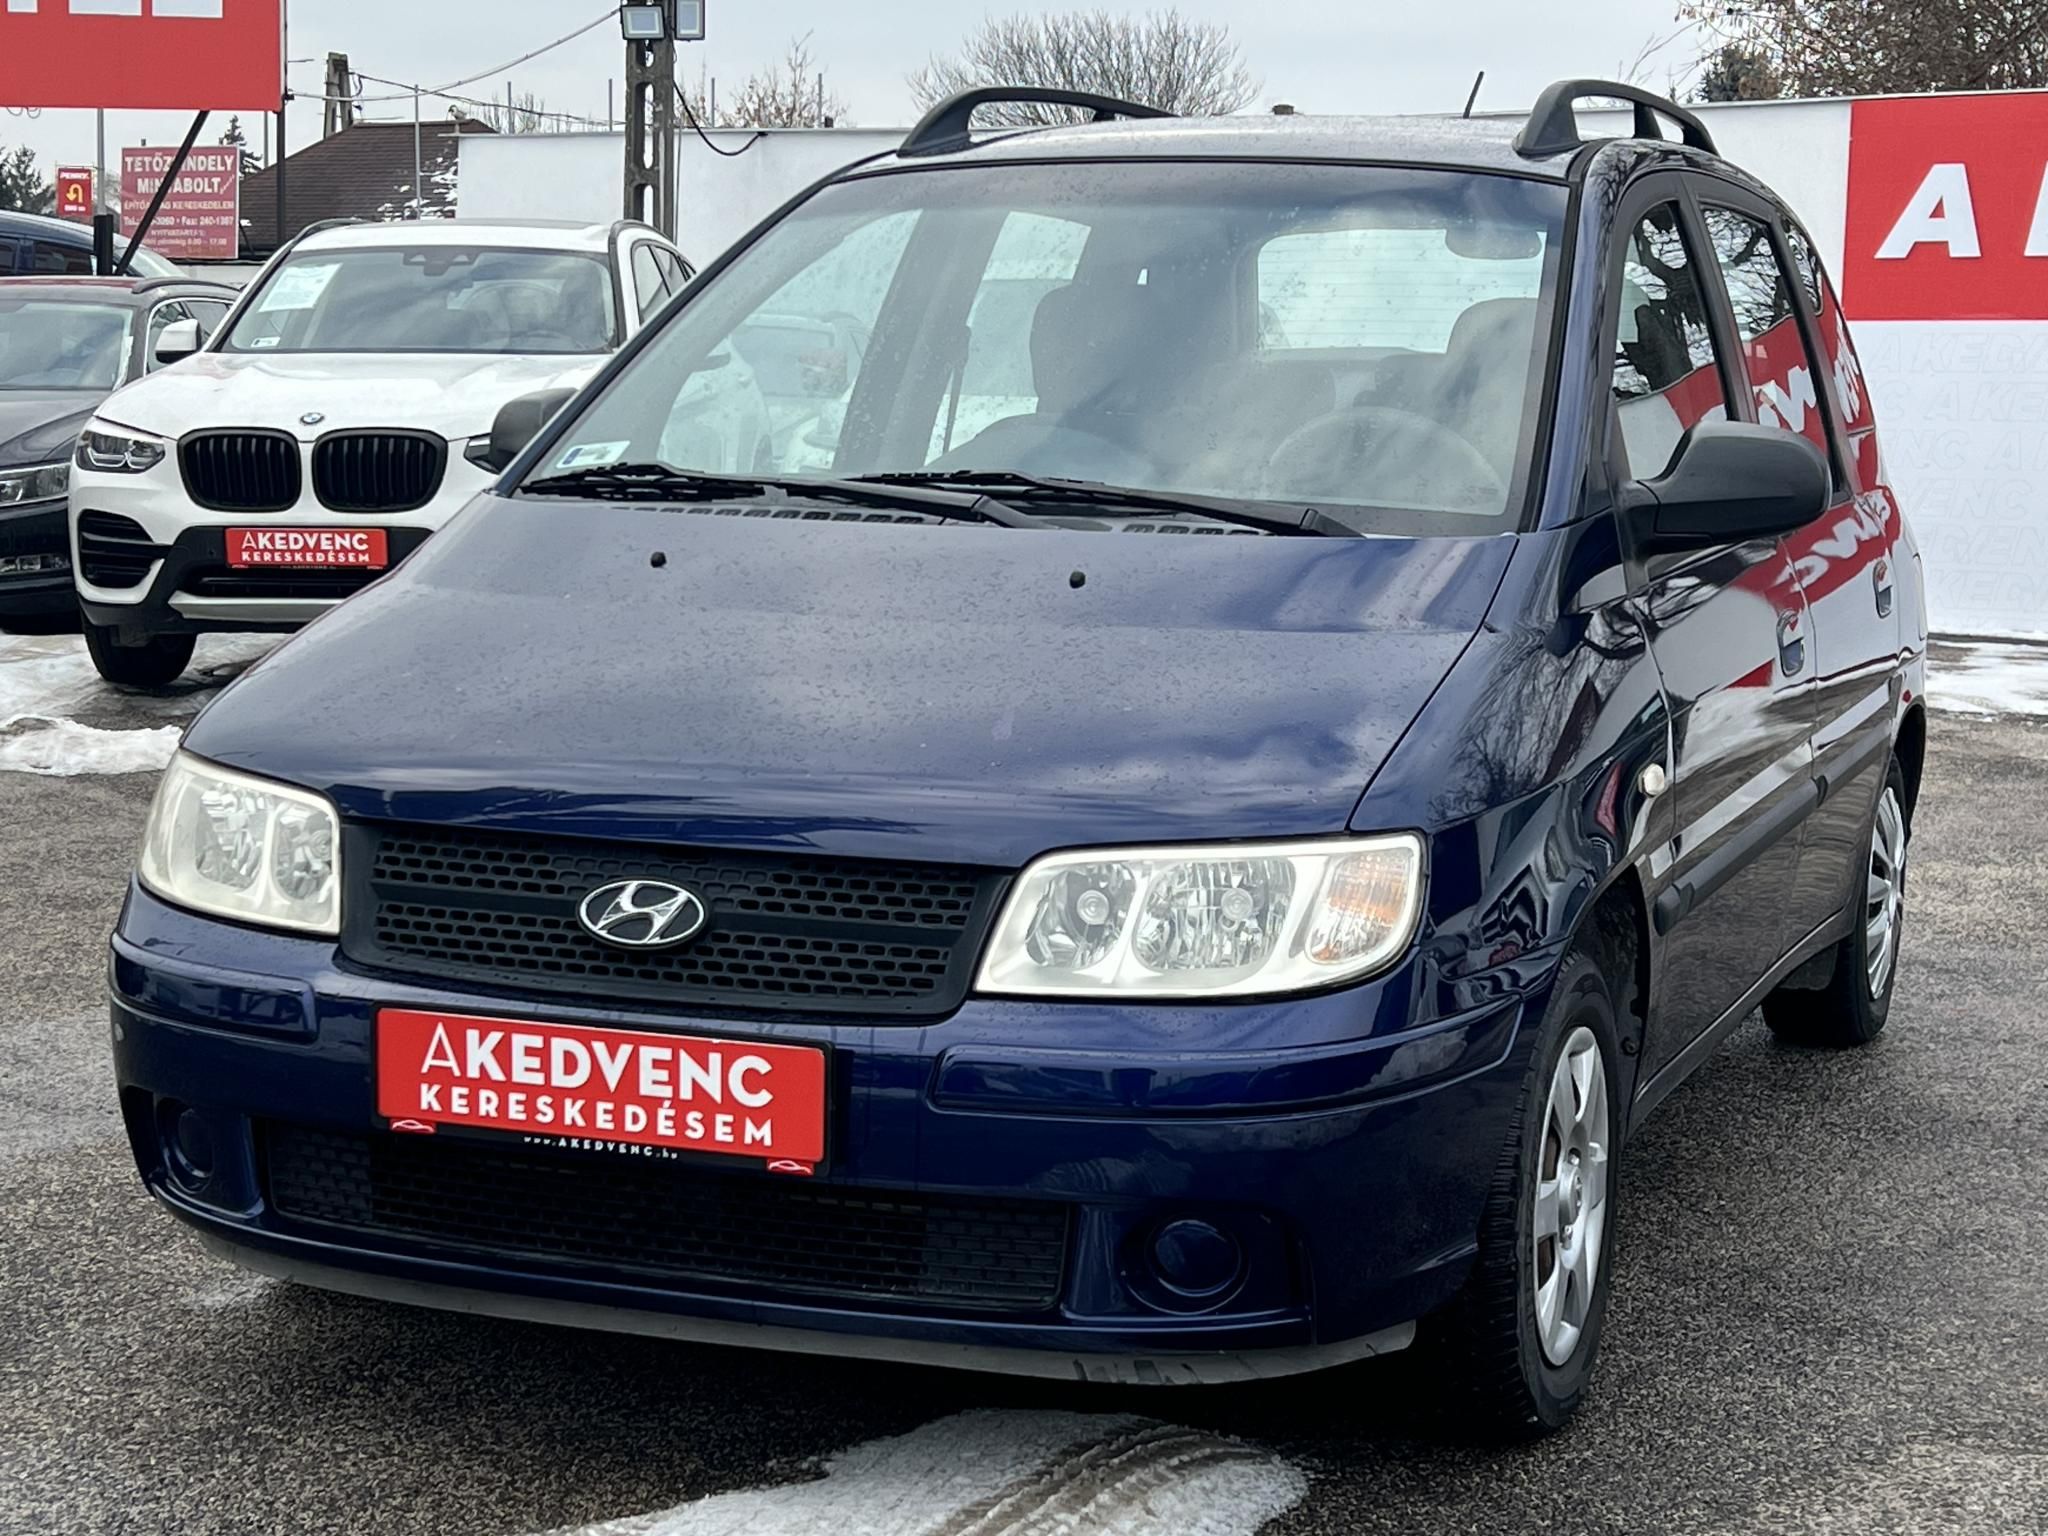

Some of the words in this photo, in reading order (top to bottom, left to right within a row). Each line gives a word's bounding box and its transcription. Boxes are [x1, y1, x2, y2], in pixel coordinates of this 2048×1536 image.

[136, 176, 221, 194] MINABOLT
[1873, 162, 1982, 259] A
[241, 550, 370, 563] KERESKEDÉSEM
[419, 1082, 773, 1147] KERESKEDÉSEM
[523, 1136, 678, 1160] www.AKEDVENC.hu
